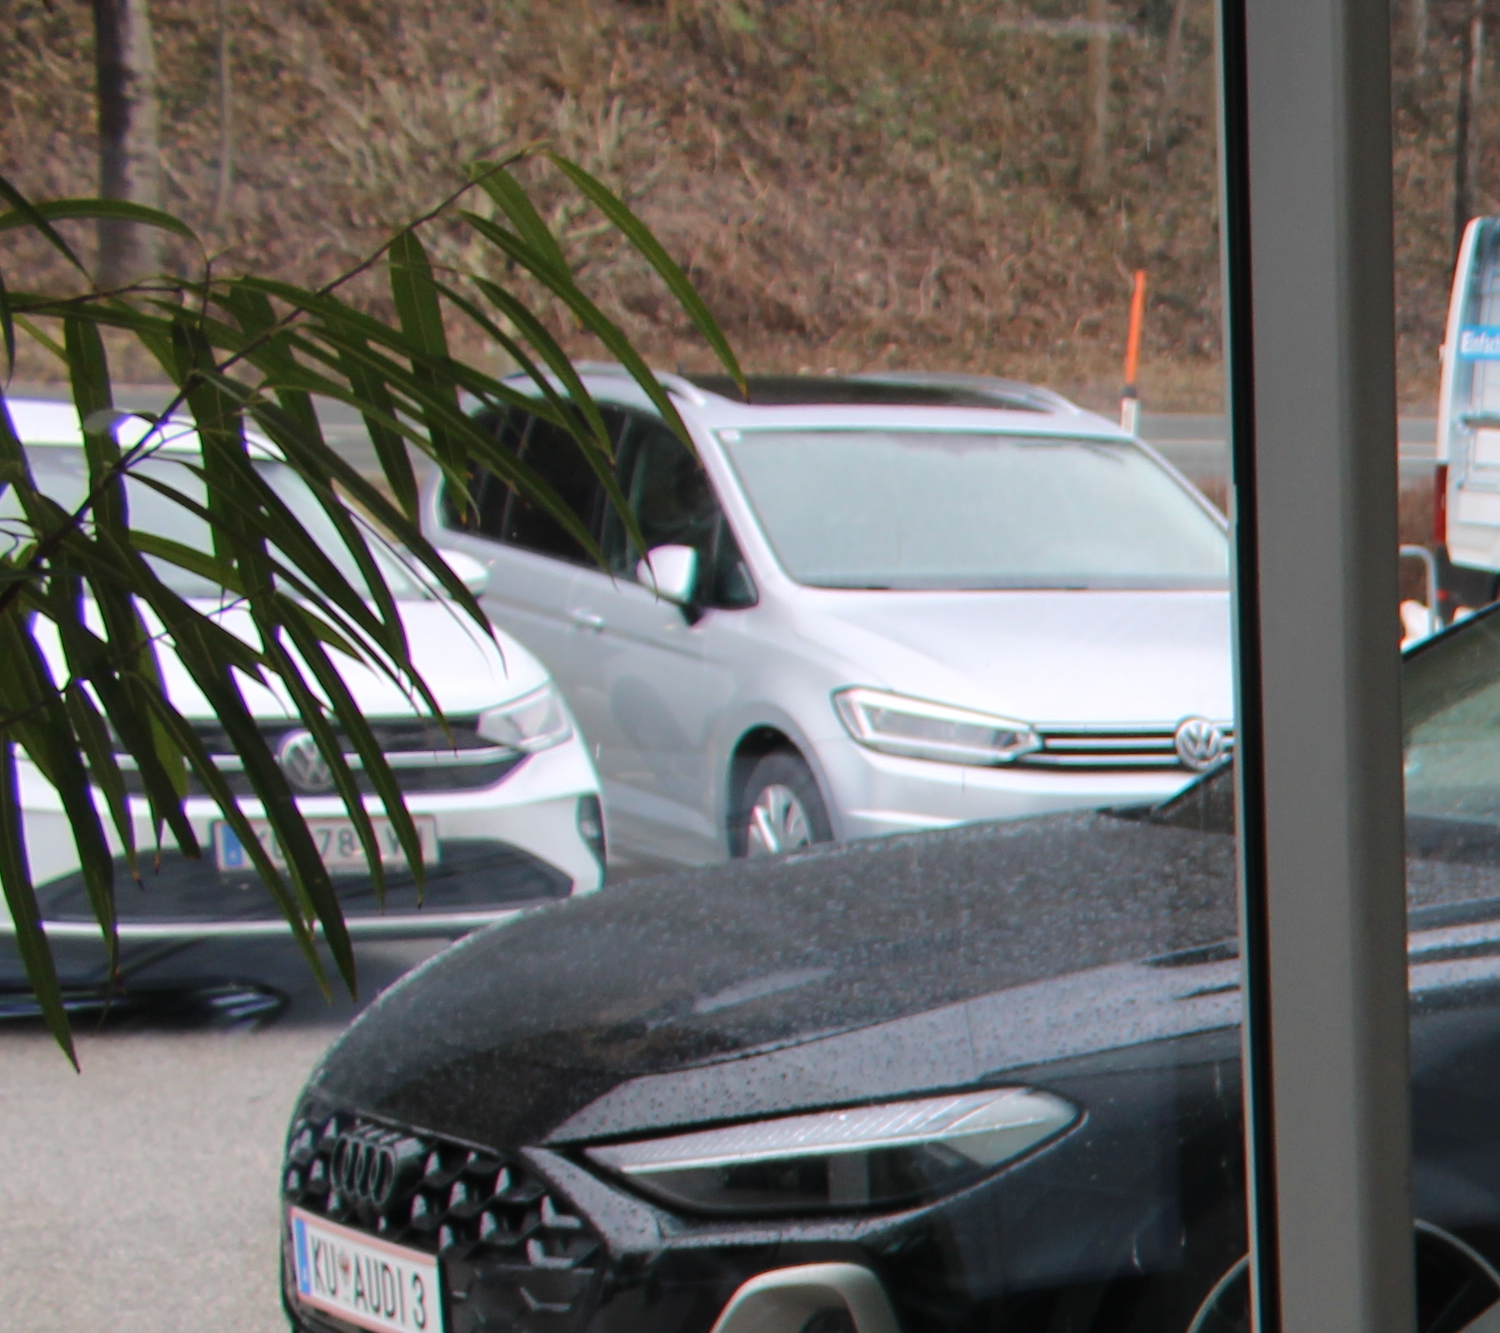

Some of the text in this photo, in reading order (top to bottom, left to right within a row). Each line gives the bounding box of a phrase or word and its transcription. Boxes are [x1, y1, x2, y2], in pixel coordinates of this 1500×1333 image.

[311, 1236, 426, 1330] KU AUDI 3
